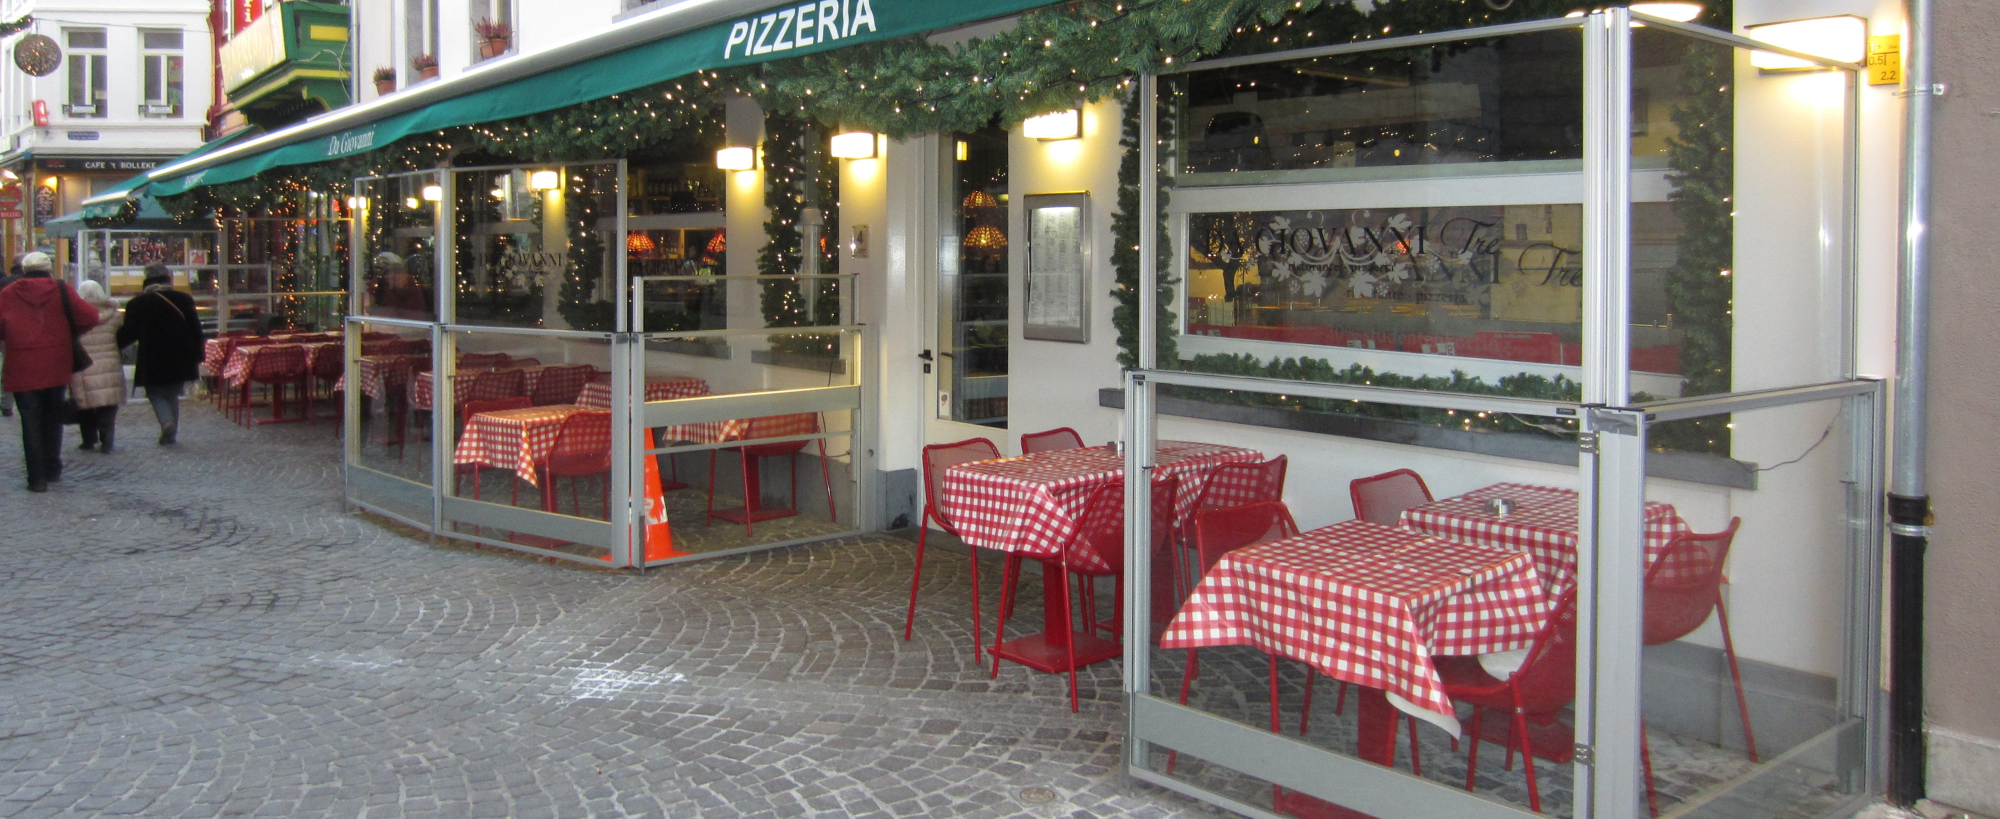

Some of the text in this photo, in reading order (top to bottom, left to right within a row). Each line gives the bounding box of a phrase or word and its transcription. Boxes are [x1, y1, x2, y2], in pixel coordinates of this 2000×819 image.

[724, 0, 877, 60] PIZZERIA
[327, 124, 376, 155] Da Giovanni
[120, 161, 157, 169] BOLLEKE
[857, 230, 865, 245] 4
[1255, 226, 1427, 256] GIOVANNI
[1440, 217, 1503, 255] Tre
